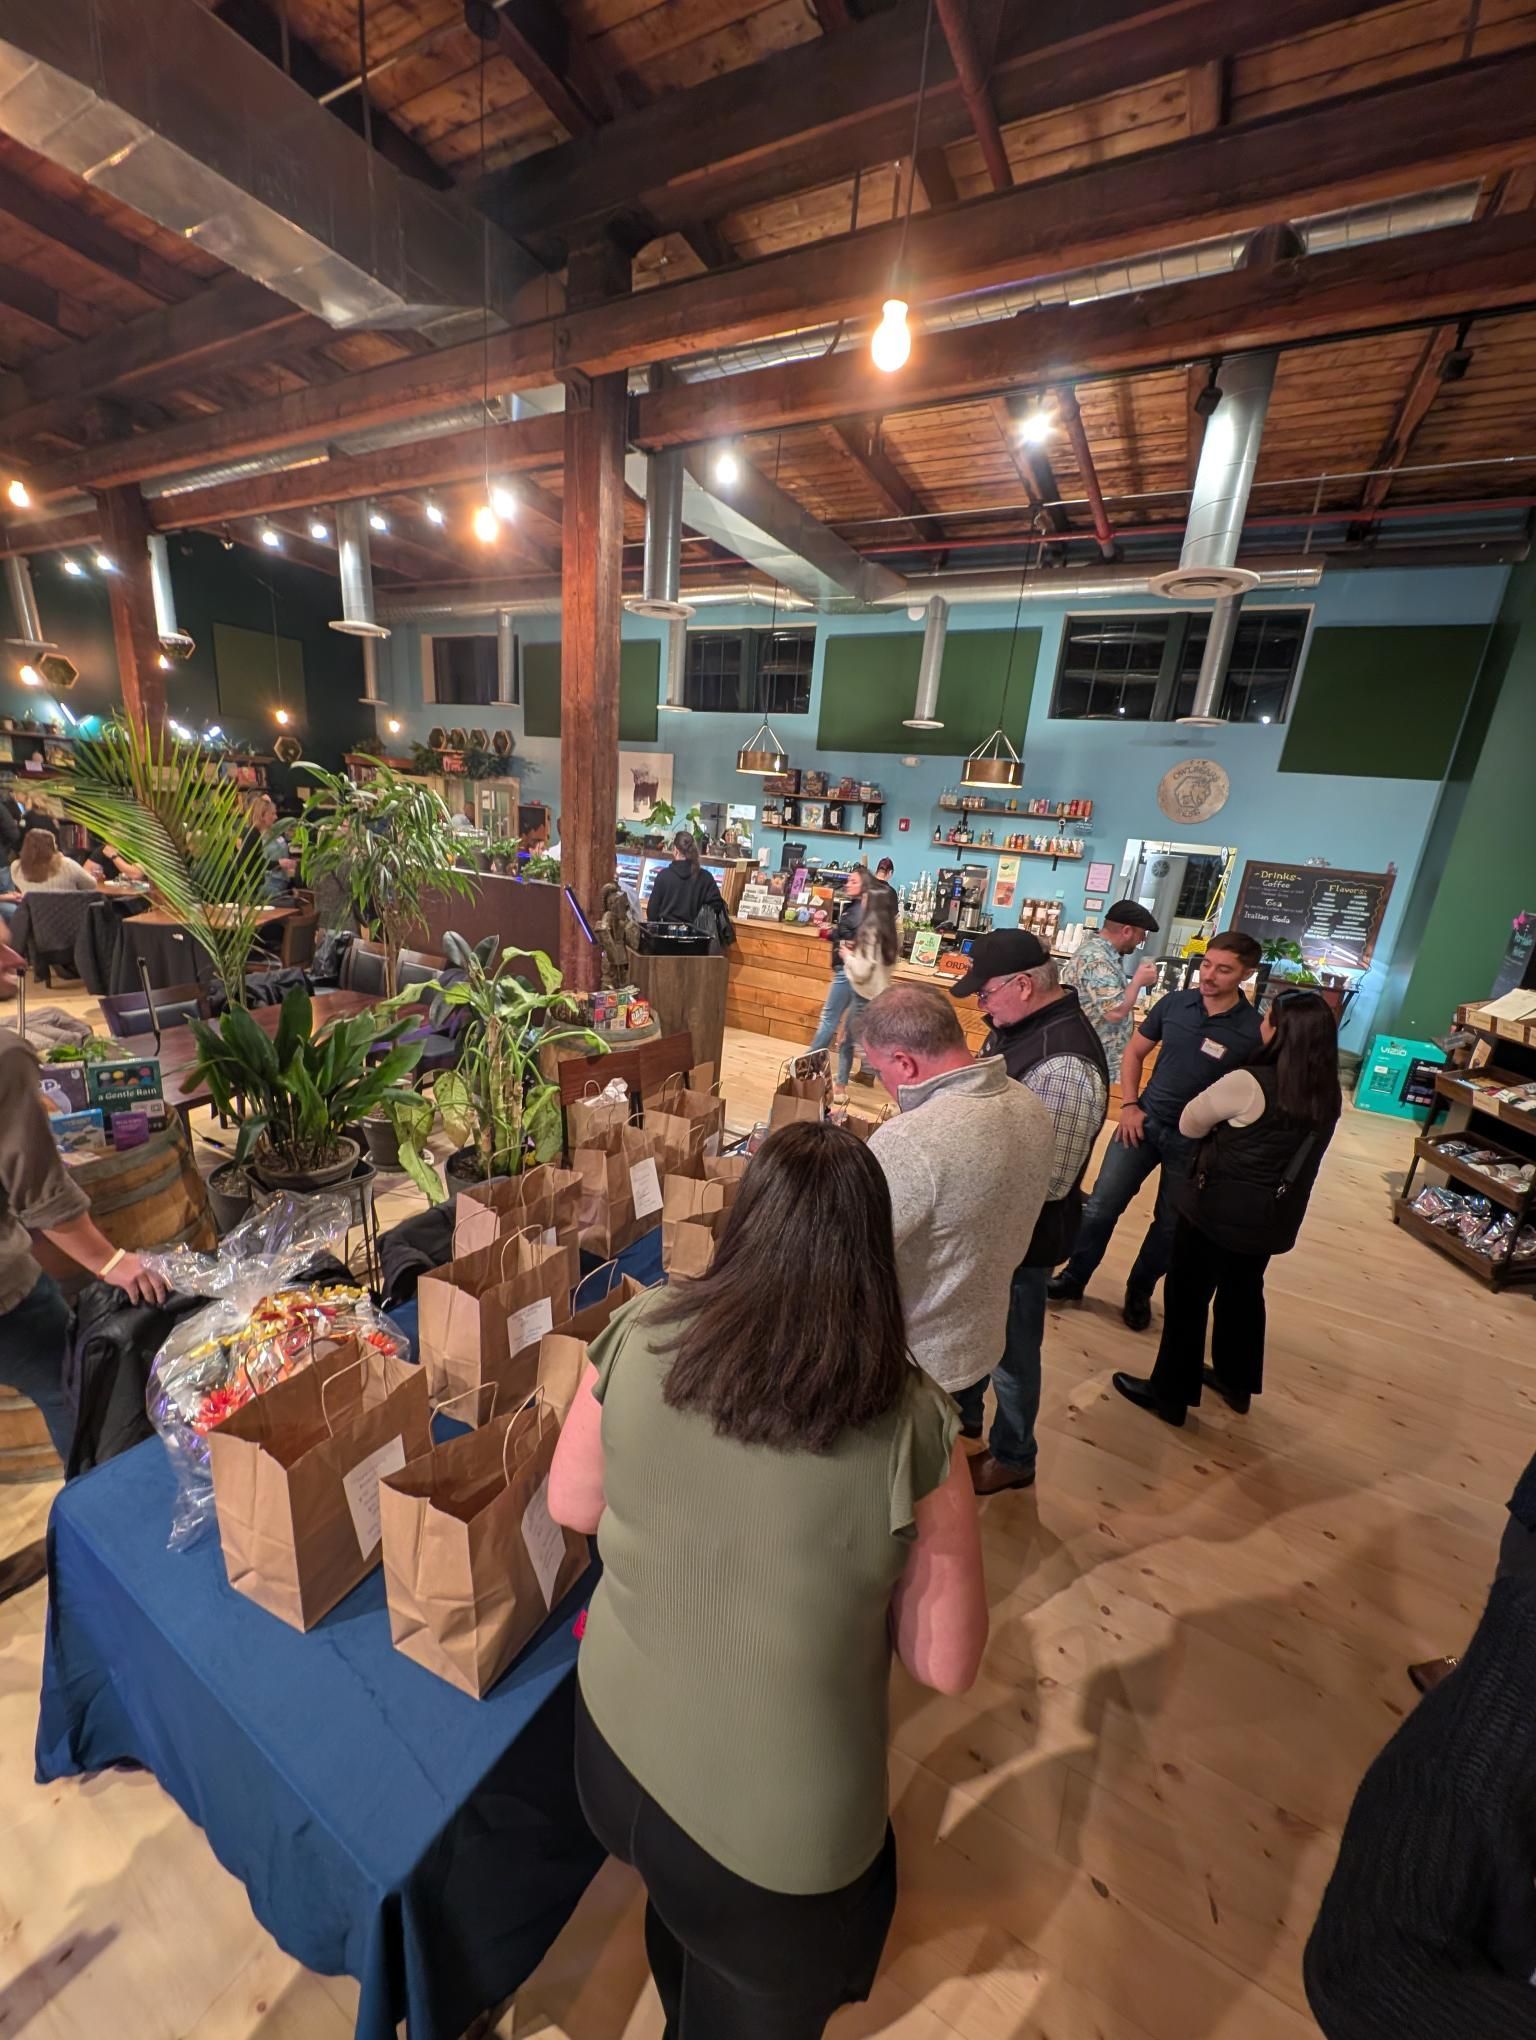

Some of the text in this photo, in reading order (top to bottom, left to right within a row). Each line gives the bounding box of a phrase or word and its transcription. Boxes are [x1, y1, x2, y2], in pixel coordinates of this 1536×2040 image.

[1262, 880, 1291, 889] Coffee
[1265, 898, 1283, 908] Tea
[1272, 914, 1291, 924] Soda
[1380, 1045, 1408, 1057] VIZIO
[105, 1089, 134, 1101] Gentle
[136, 1087, 157, 1097] Rain
